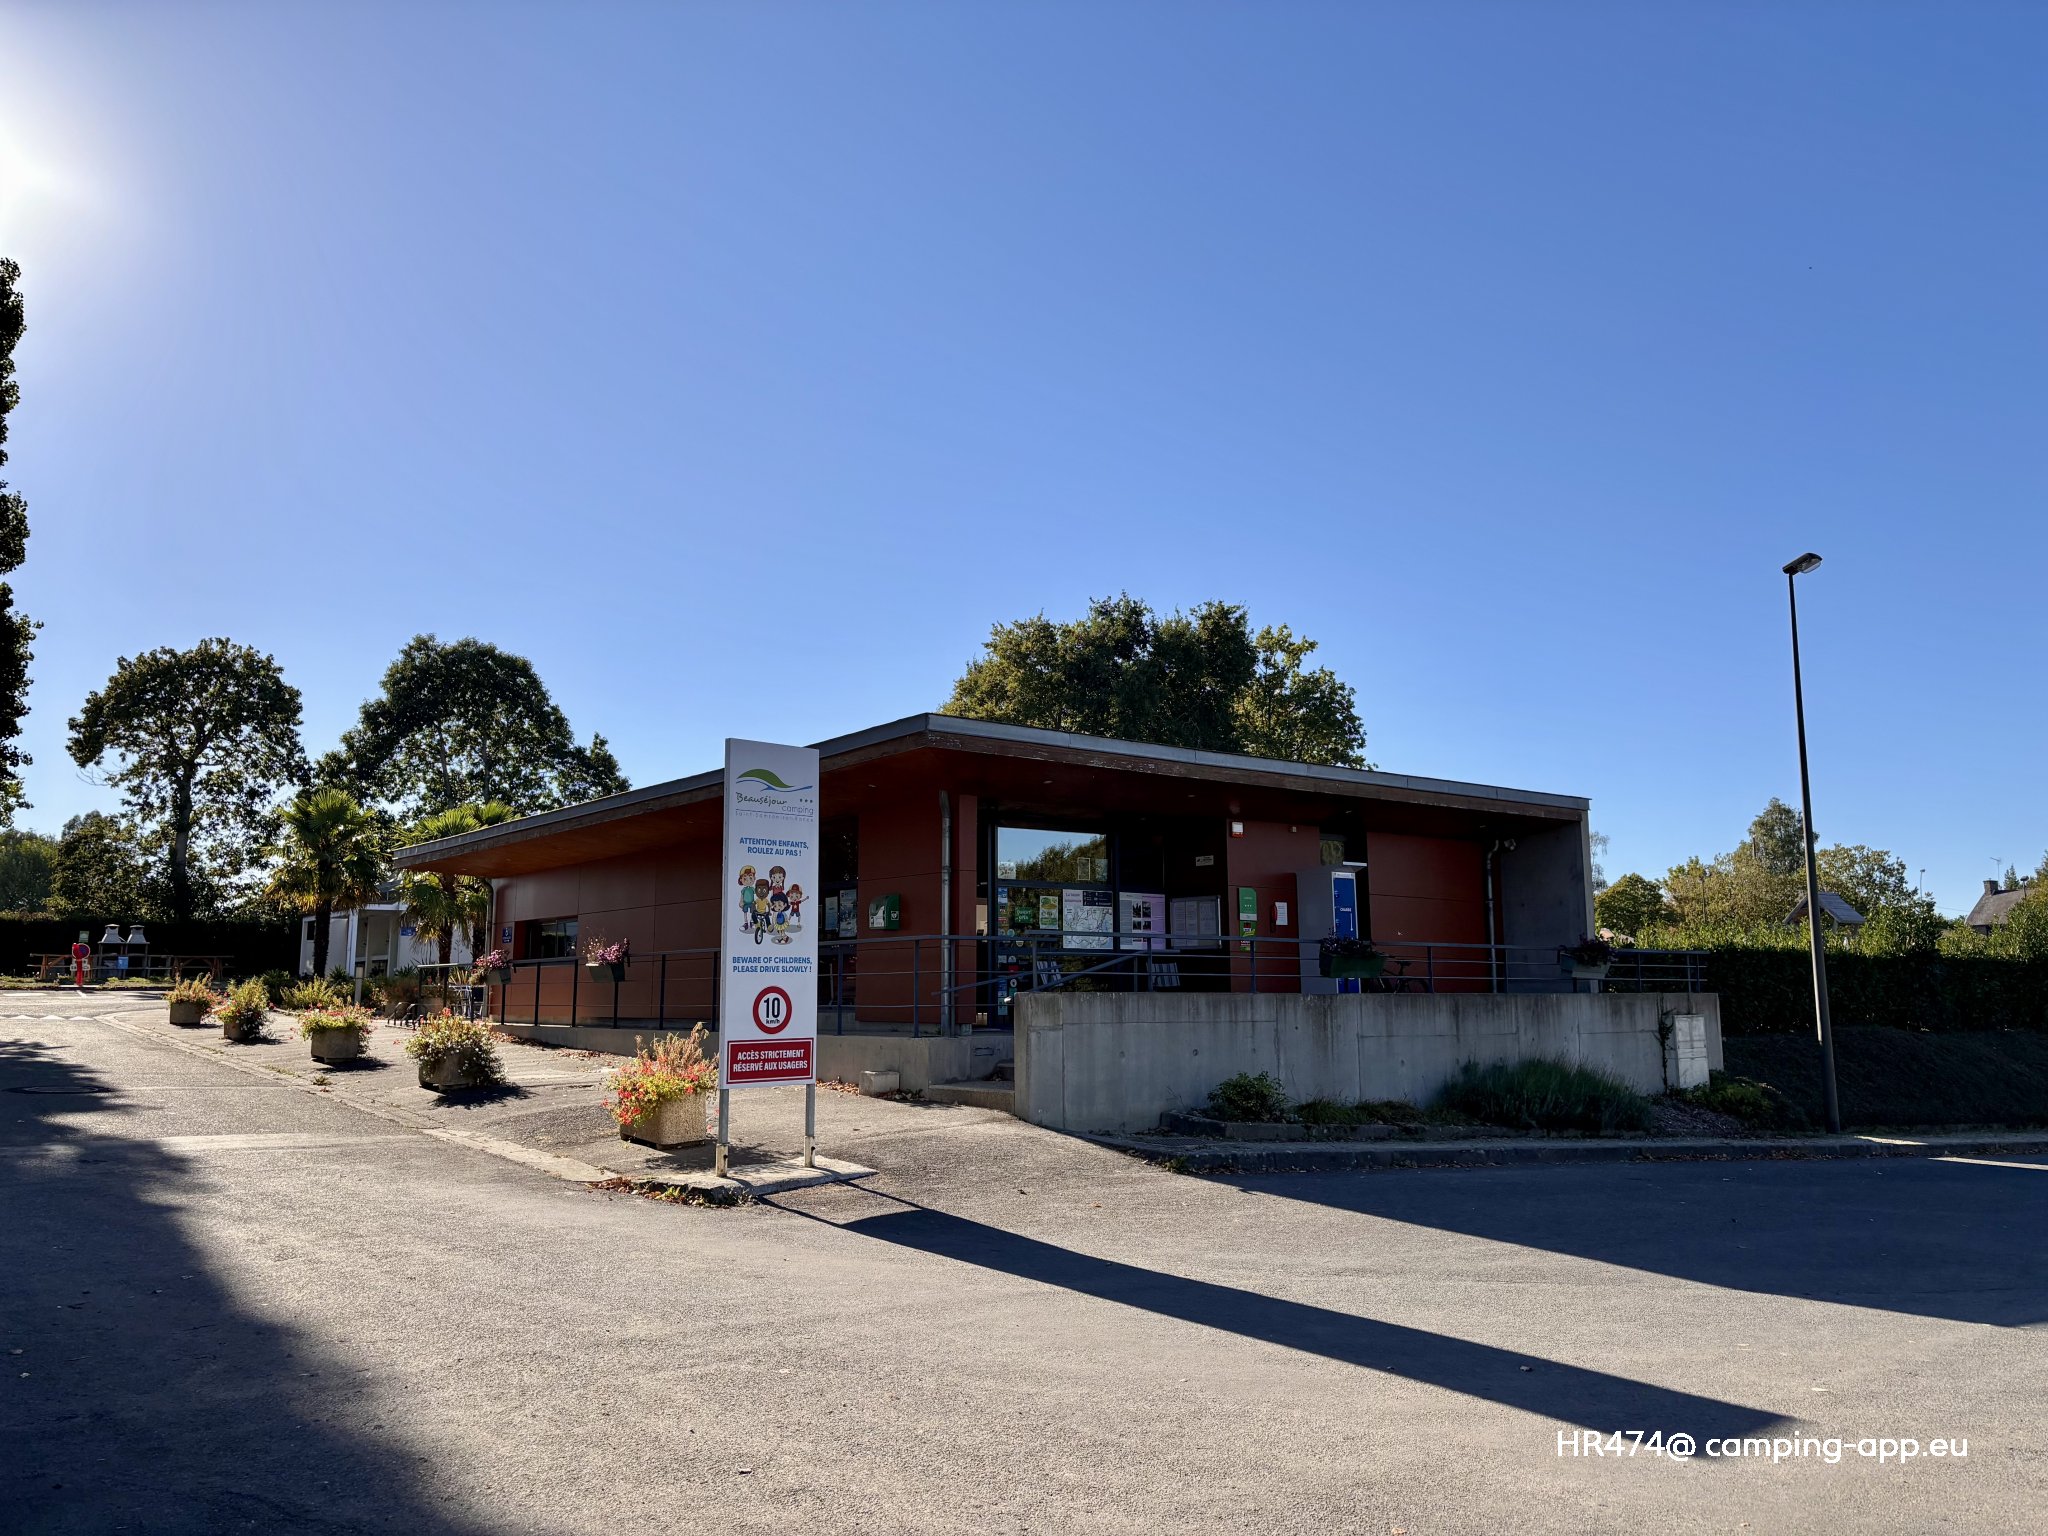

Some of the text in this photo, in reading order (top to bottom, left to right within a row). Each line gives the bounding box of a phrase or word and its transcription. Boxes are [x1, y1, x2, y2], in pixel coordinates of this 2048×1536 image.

[736, 792, 787, 807] Beauséjour
[782, 804, 814, 816] camping
[739, 837, 809, 850] ATTENTION ENFANTS,
[747, 846, 774, 855] ROULEZ
[774, 848, 784, 856] AU
[785, 849, 798, 857] PAS
[732, 956, 813, 965] BEWARE OF CHILDRENS,
[732, 965, 758, 973] PLEASE
[759, 965, 780, 973] DRIVE
[781, 965, 808, 973] SLOWLY
[763, 997, 781, 1019] 10
[737, 1049, 805, 1061] ACCÈS STRICTEMENT
[733, 1060, 808, 1072] RÉSERVÉ AUX USAGERS
